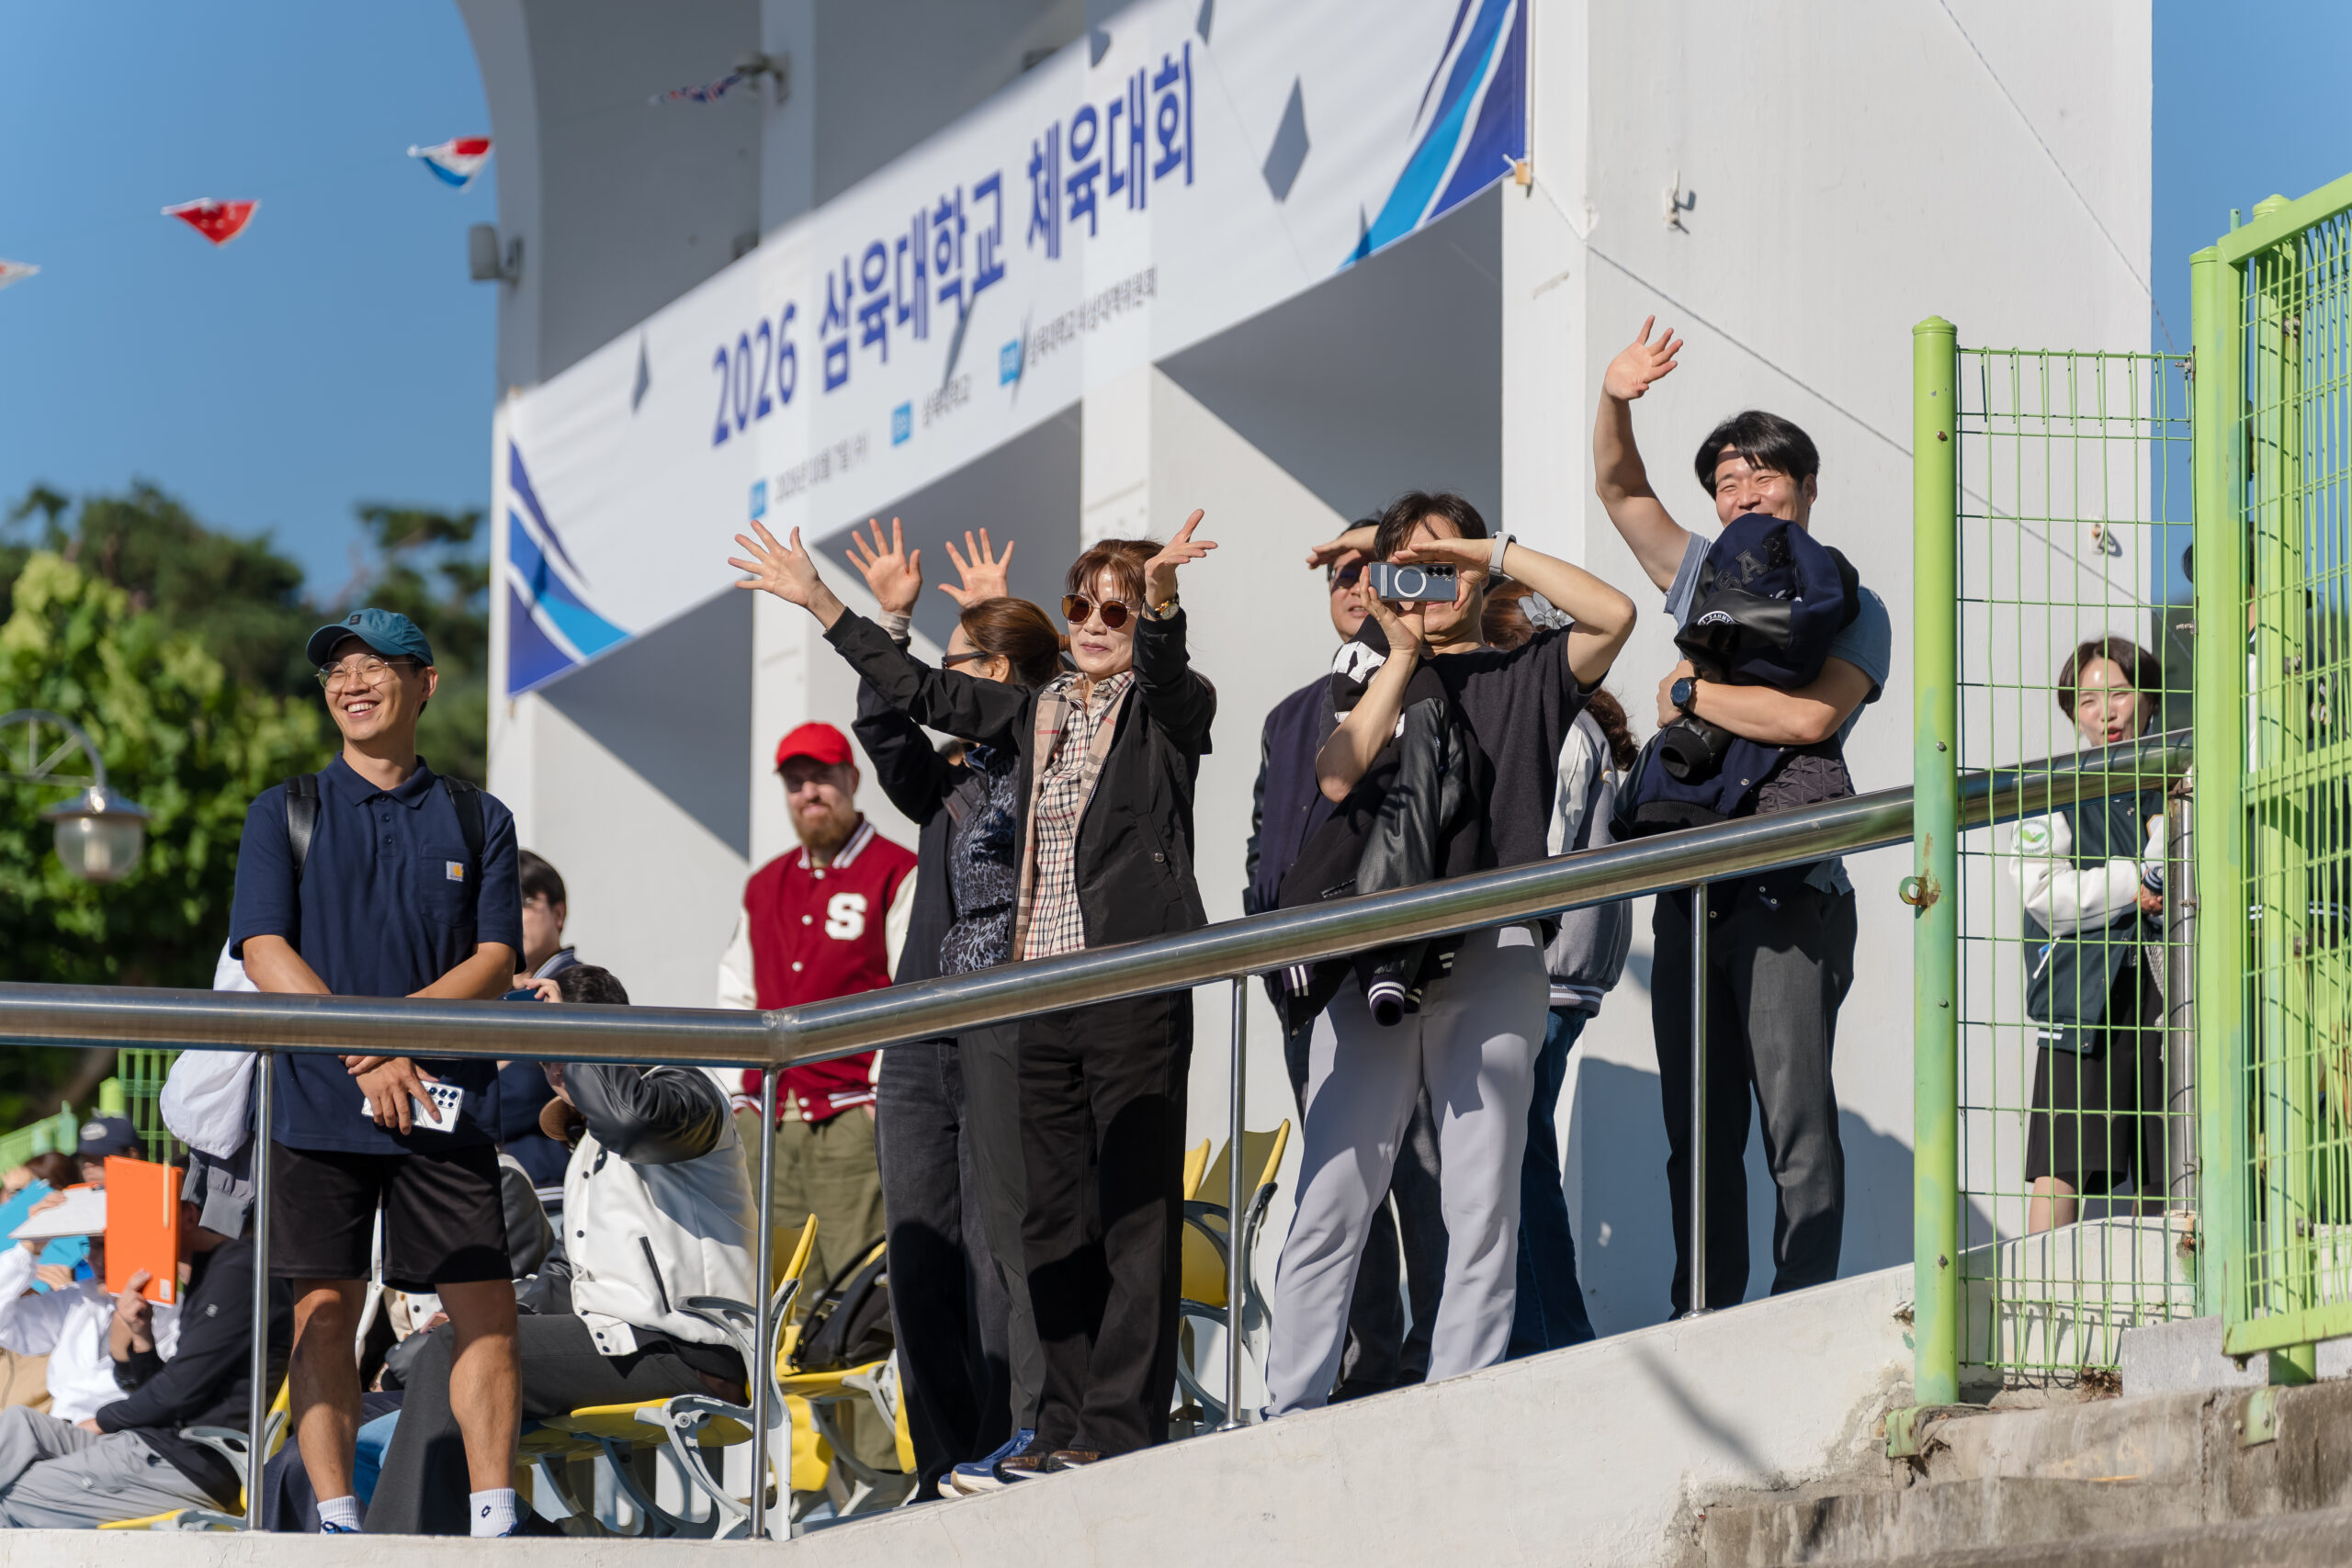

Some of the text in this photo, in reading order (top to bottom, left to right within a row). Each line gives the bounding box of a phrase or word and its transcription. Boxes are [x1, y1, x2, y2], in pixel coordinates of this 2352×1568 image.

[712, 40, 1193, 447] 2026 삼육대학교 체육대회
[1709, 613, 1734, 625] SAHMY
[825, 892, 868, 941] S
